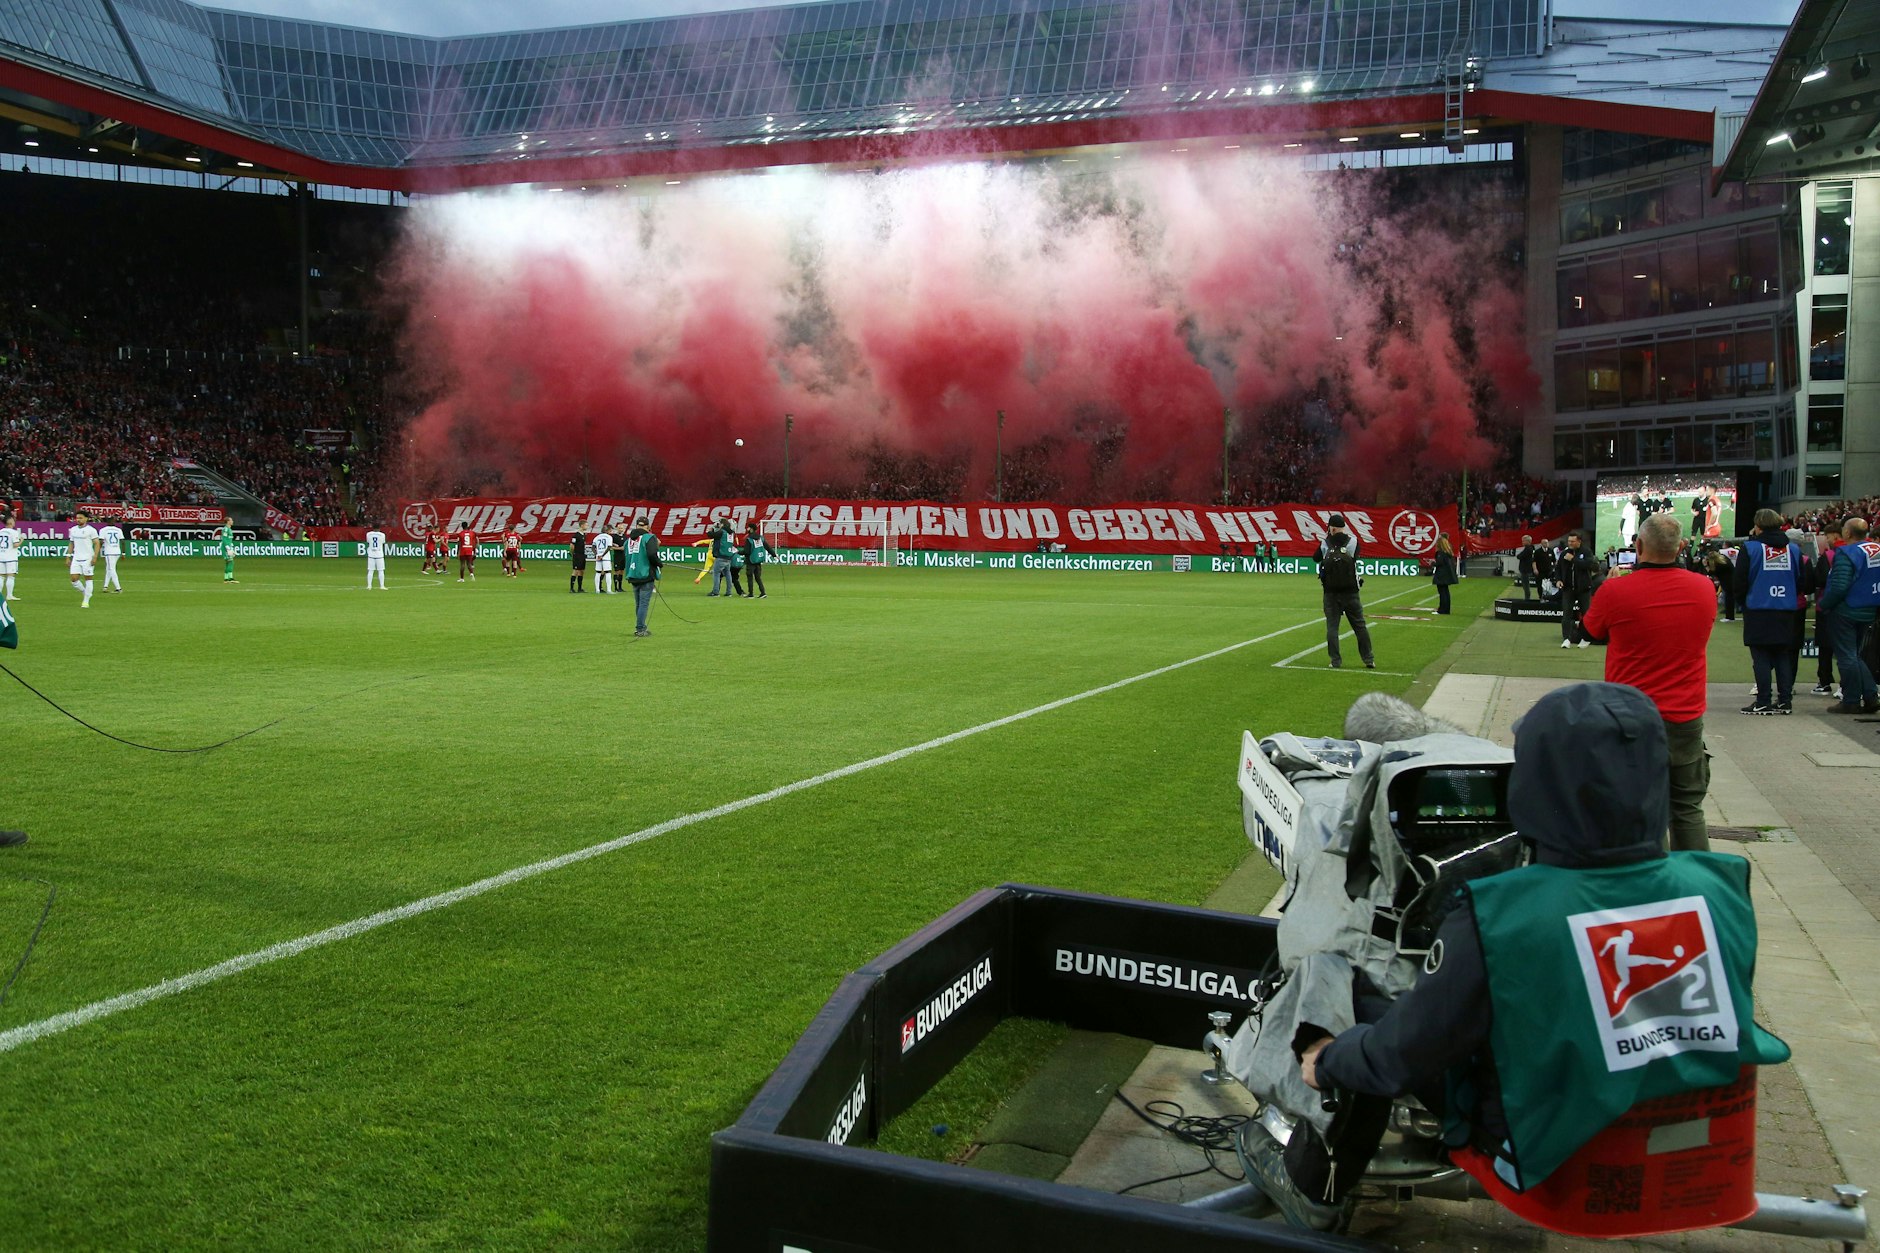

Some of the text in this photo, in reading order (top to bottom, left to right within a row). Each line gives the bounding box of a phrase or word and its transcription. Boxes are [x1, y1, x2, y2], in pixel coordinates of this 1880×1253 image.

[265, 509, 297, 536] Pfalz
[447, 504, 514, 535] WIR
[517, 503, 659, 535] STEHEN
[661, 504, 757, 536] FEST
[763, 503, 969, 537] ZUSAMMEN
[978, 507, 1060, 540] UND
[1067, 508, 1206, 542] GEBEN
[1205, 510, 1292, 543] NIE
[107, 532, 119, 545] 25
[372, 536, 379, 548] 8
[464, 535, 470, 546] 9
[507, 540, 518, 548] 20
[130, 542, 149, 556] Bei
[153, 542, 200, 556] Muskel-
[234, 542, 310, 557] elenkschmerzen
[384, 543, 426, 557] Muskel
[896, 551, 1153, 571] Bei Muskel- und Gelenkschmerzen
[1211, 557, 1236, 573] Bei
[1769, 585, 1786, 597] 02
[1251, 765, 1294, 831] BUNDESLIGA
[1680, 963, 1711, 1010] 2
[916, 956, 993, 1042] BUNDESLIGA
[1616, 1025, 1727, 1056] BUNDESLIGA
